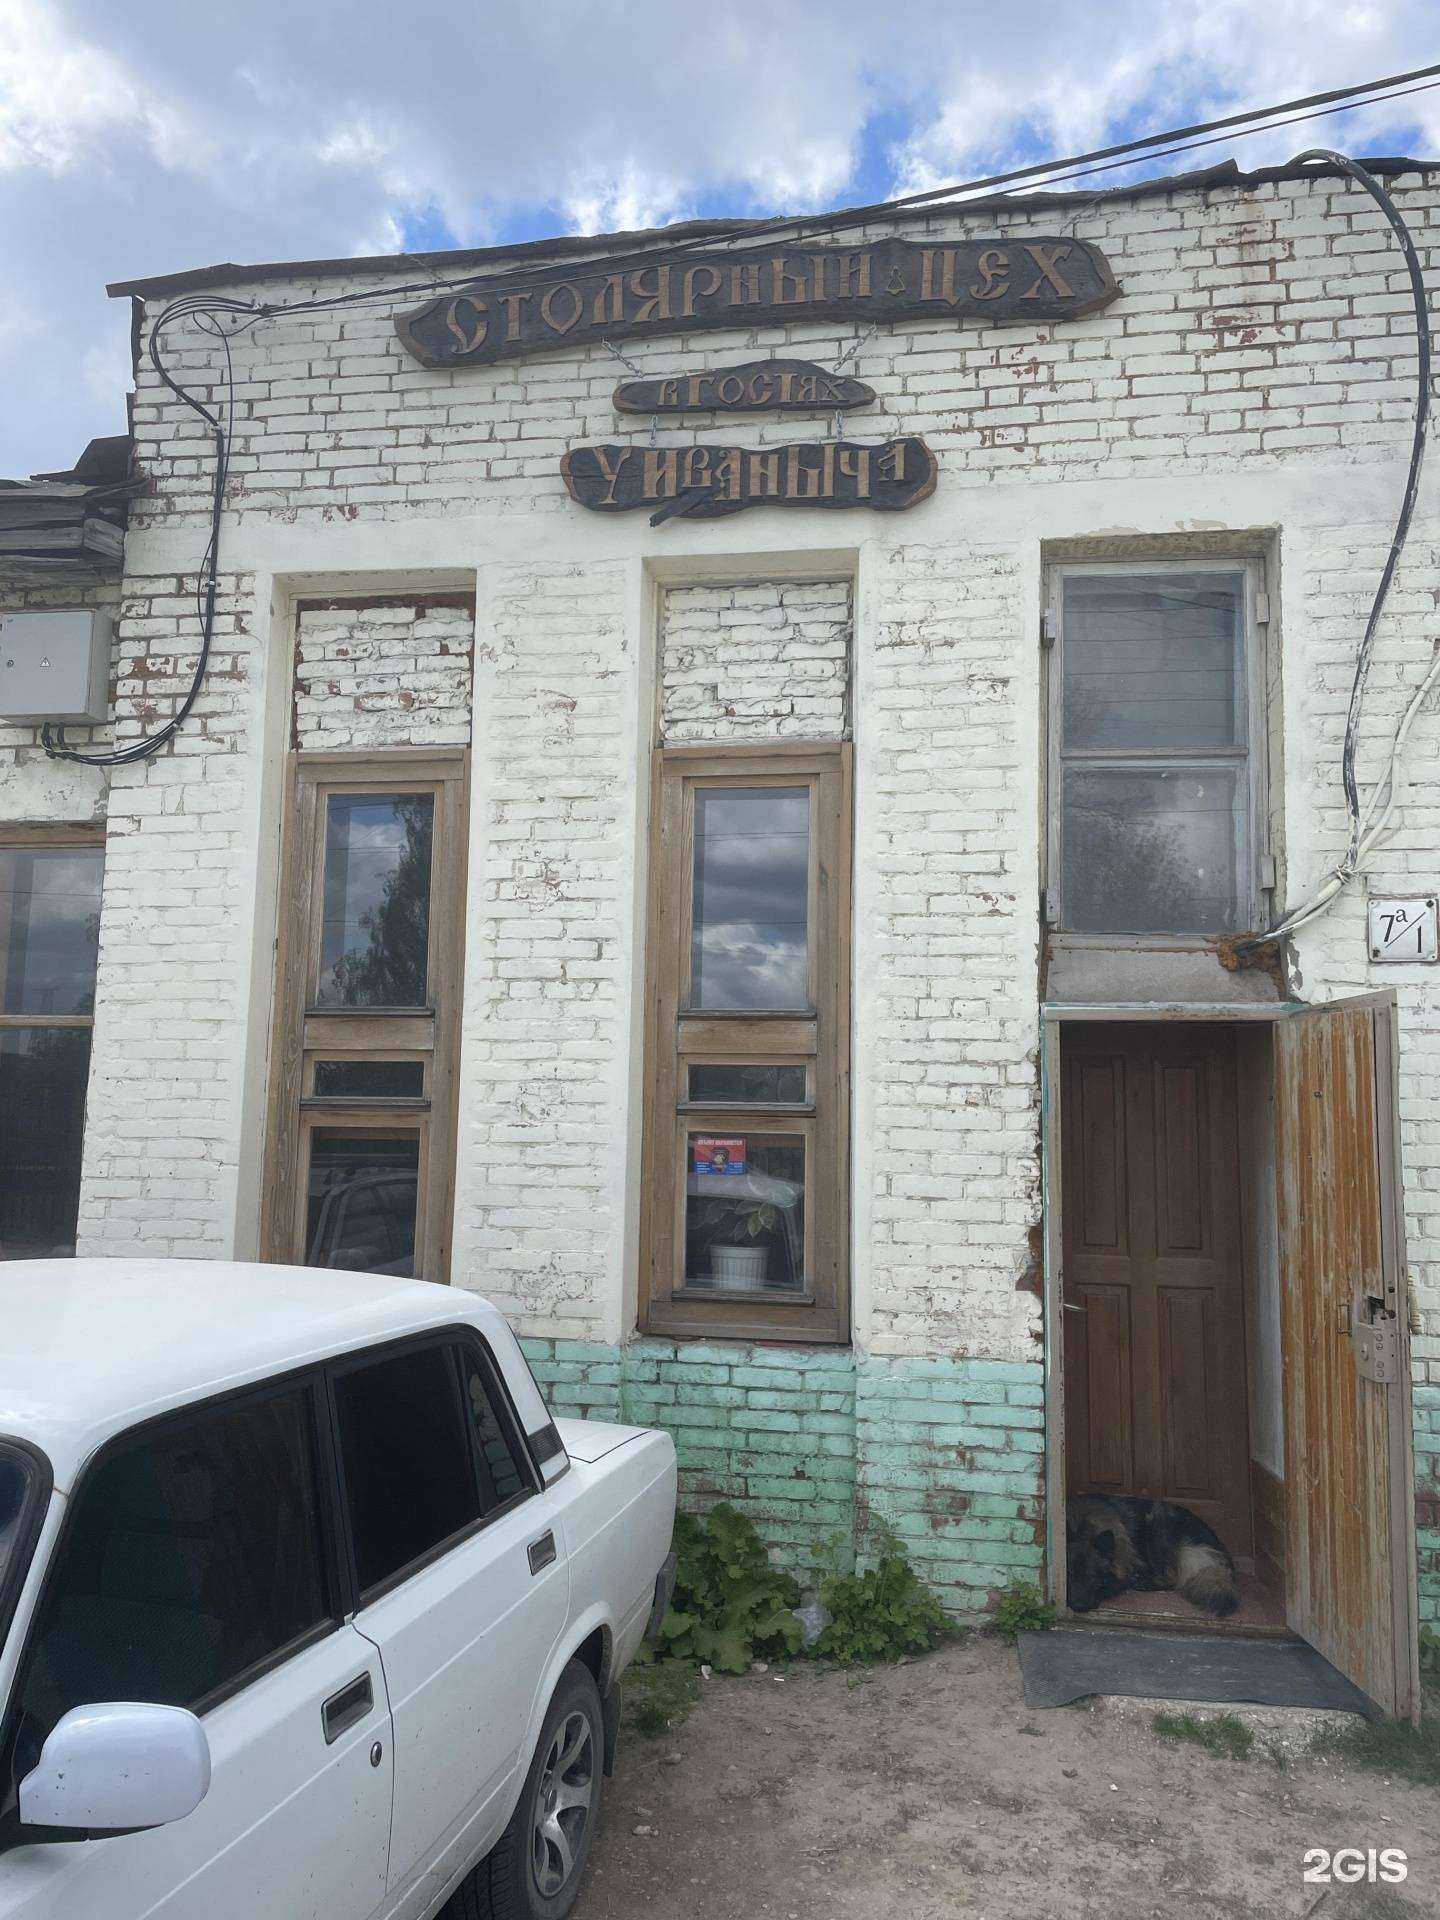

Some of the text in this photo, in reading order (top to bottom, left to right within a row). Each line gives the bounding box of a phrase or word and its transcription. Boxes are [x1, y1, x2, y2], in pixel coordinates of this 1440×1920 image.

[920, 245, 1077, 308] ЦЕХ
[683, 372, 848, 407] ГОСТЯХ
[592, 443, 907, 505] У ИВАНЫЧА
